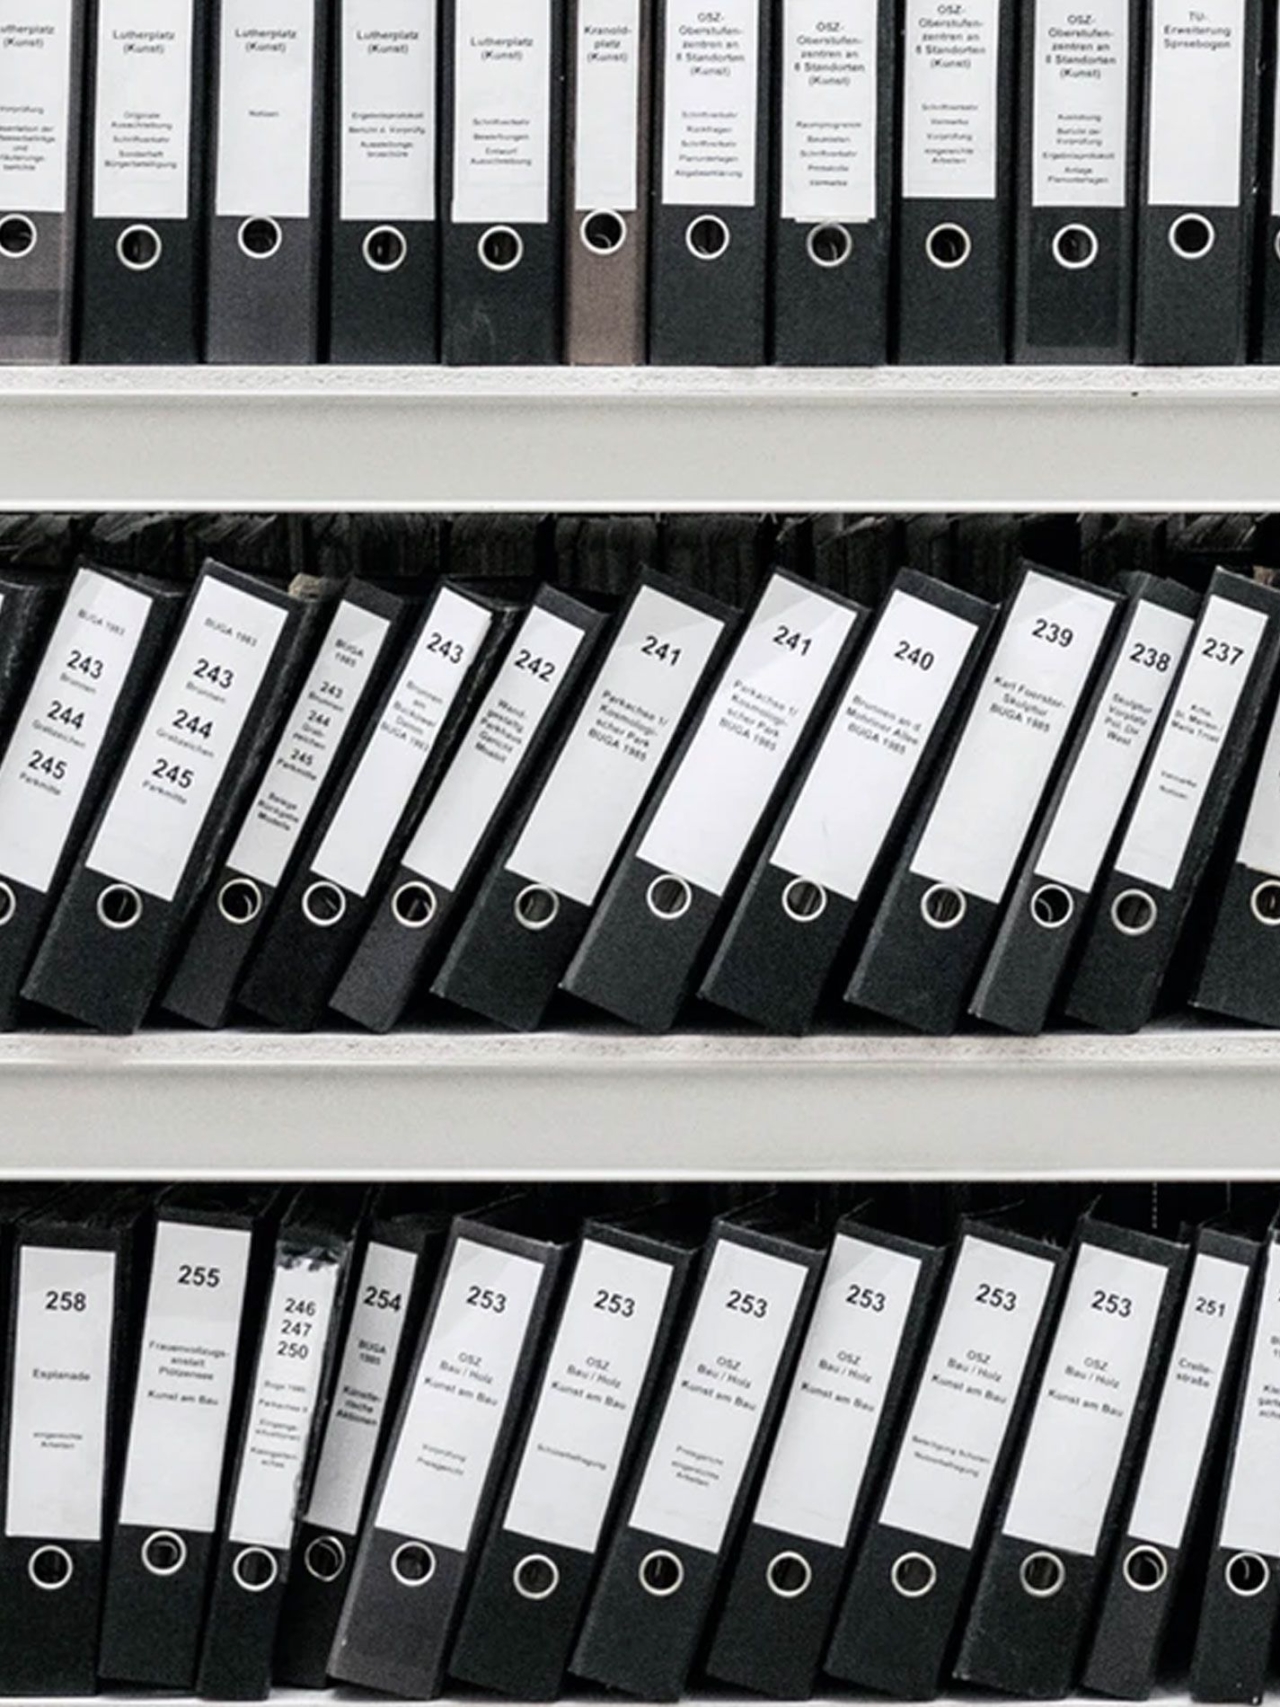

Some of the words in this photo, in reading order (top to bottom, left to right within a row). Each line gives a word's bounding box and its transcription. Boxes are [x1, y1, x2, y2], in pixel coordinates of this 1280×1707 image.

[0, 24, 56, 37] utherplatz
[112, 30, 175, 42] Lutherplatz
[234, 28, 297, 40] Lutherplatz
[594, 39, 621, 50] platz
[123, 43, 165, 54] (Kunst)
[245, 42, 286, 53] (Kunst)
[772, 624, 812, 657] 241
[1031, 617, 1074, 648] 239
[425, 631, 465, 665] 243
[640, 634, 682, 667] 241
[893, 640, 935, 672] 240
[1128, 642, 1171, 673] 238
[1200, 637, 1245, 666] 237
[66, 649, 104, 680] 243
[192, 657, 235, 690] 243
[513, 648, 556, 683] 242
[319, 681, 343, 700] 243
[46, 699, 85, 731] 244
[171, 708, 214, 740] 244
[307, 709, 331, 728] 244
[27, 749, 68, 781] 245
[290, 748, 314, 767] 245
[151, 757, 195, 790] 245
[177, 1264, 221, 1289] 255
[45, 1290, 87, 1313] 258
[283, 1297, 317, 1318] 246
[362, 1285, 403, 1313] 254
[465, 1285, 507, 1314] 253
[593, 1288, 636, 1319] 253
[725, 1289, 768, 1319] 253
[845, 1283, 887, 1313] 253
[974, 1283, 1017, 1312] 253
[1090, 1289, 1132, 1319] 253
[1194, 1296, 1226, 1318] 251
[280, 1318, 313, 1338] 247
[276, 1340, 309, 1360] 250
[32, 1368, 91, 1382] Esplanade
[424, 1376, 456, 1393] Kunst
[458, 1388, 474, 1398] am
[476, 1392, 498, 1406] Bau
[1047, 1389, 1080, 1405] Kunst
[1082, 1400, 1099, 1410] am
[1101, 1403, 1124, 1418] Bau
